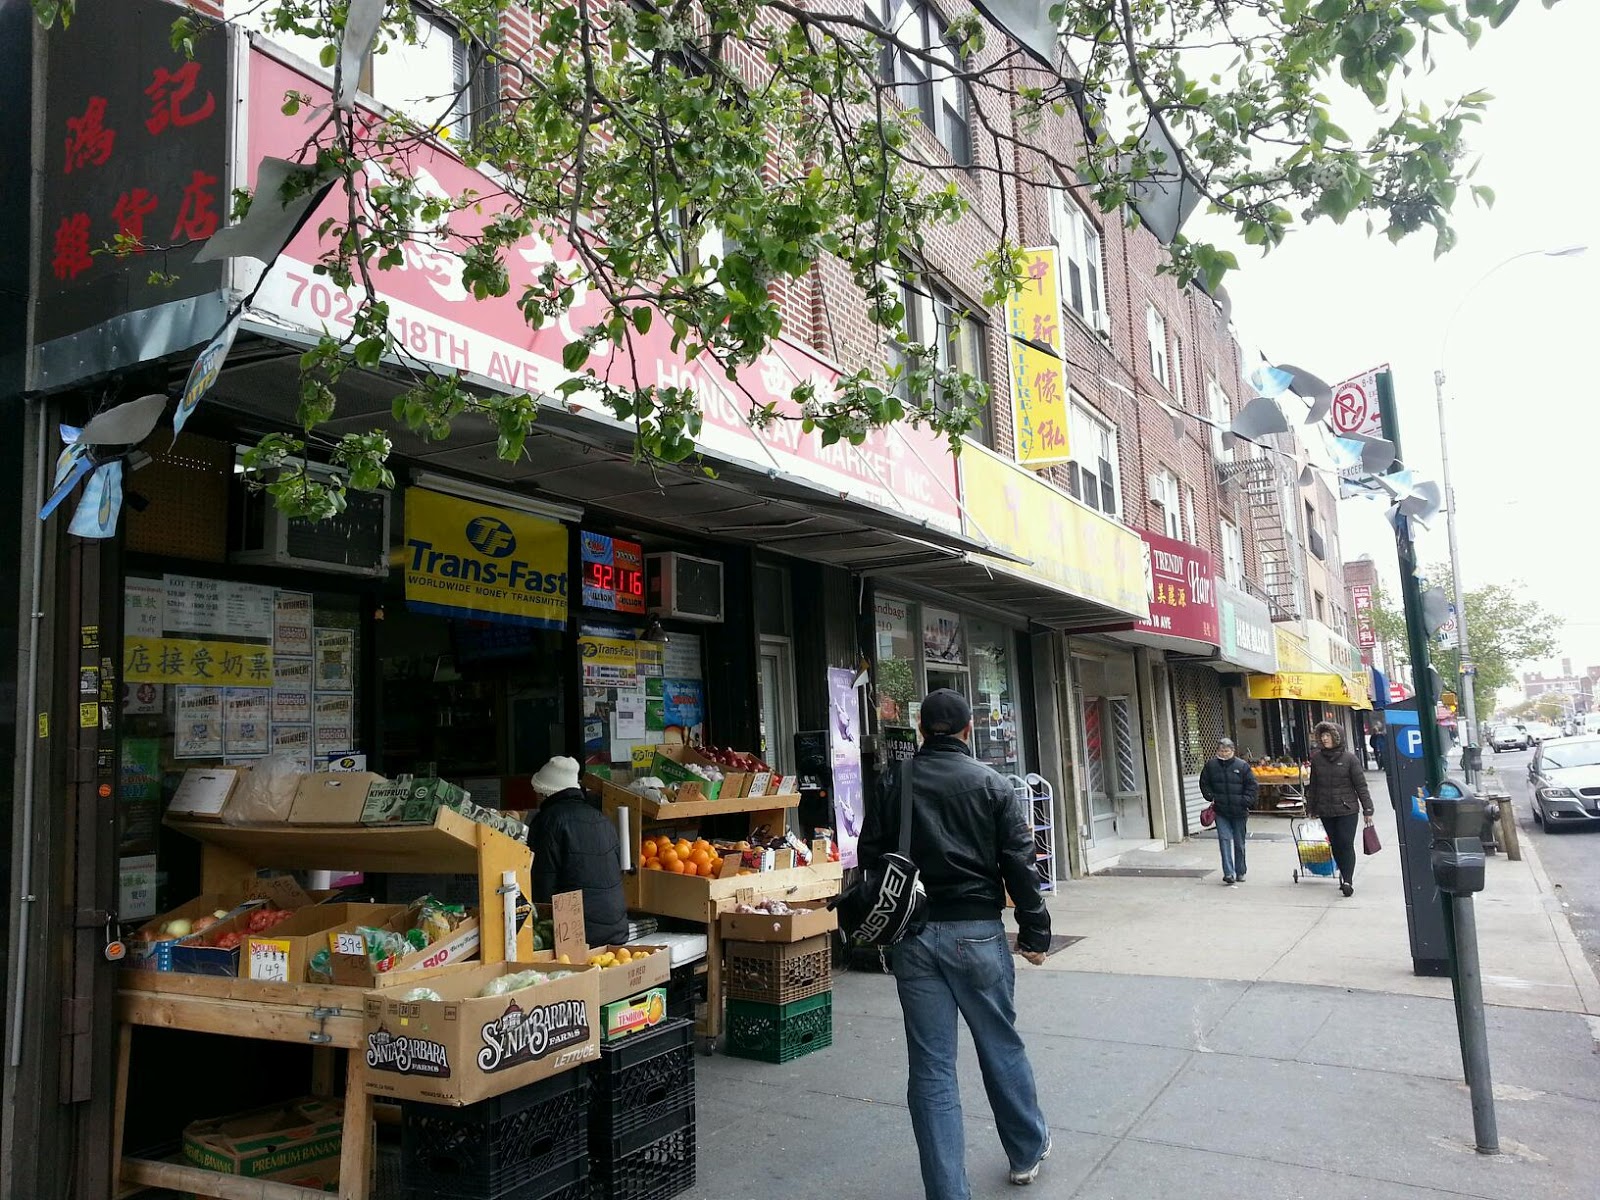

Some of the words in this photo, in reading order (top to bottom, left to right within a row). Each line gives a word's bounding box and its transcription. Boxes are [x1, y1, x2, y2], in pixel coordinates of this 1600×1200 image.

[286, 271, 371, 327] 702
[395, 316, 470, 370] 18TH
[751, 410, 801, 451] AY
[813, 424, 896, 491] MARKET
[408, 538, 568, 597] Trans-Fast
[1153, 549, 1184, 575] TRENDY
[408, 575, 471, 593] WORLDWIDE
[475, 587, 508, 598] MONEY
[593, 563, 612, 590] 92
[477, 1018, 533, 1070] SANTA
[528, 1001, 588, 1055] BARBARA
[548, 1029, 580, 1046] FARMS
[366, 1033, 399, 1066] SANTA
[396, 1036, 448, 1071] BARBARA
[553, 1044, 595, 1068] LETTUCE
[411, 1063, 439, 1072] FARMS
[252, 1149, 299, 1173] PREMIUM
